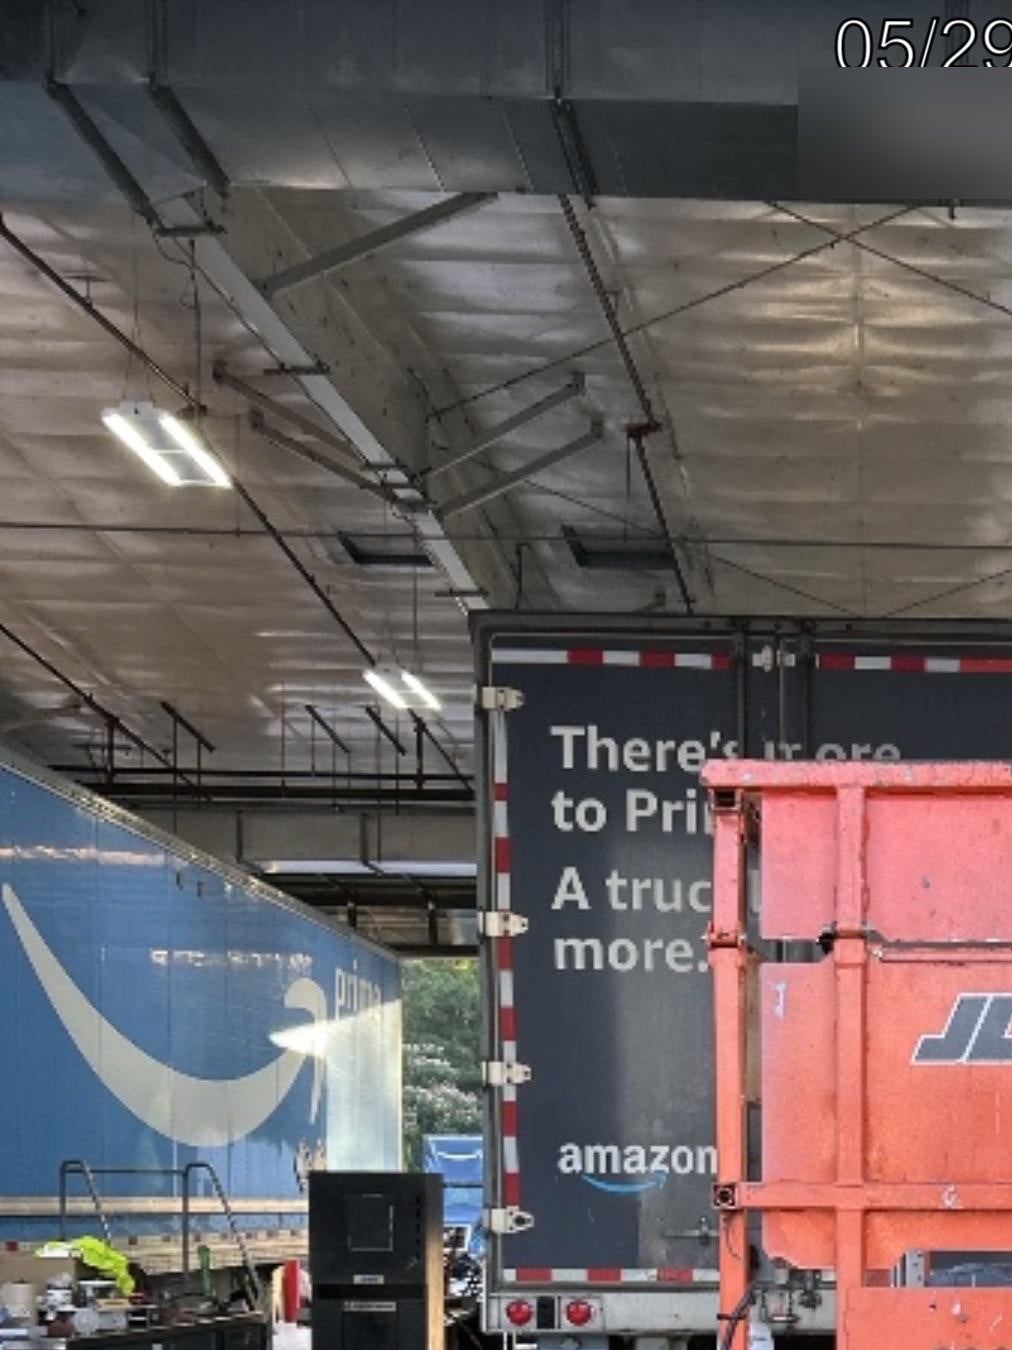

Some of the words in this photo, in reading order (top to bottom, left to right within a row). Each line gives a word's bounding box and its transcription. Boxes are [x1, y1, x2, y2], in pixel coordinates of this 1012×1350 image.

[552, 789, 607, 833] to
[625, 787, 713, 834] Pri
[551, 866, 591, 910] A
[605, 869, 712, 913] truc
[554, 937, 709, 973] more.
[557, 1141, 718, 1175] amazon
